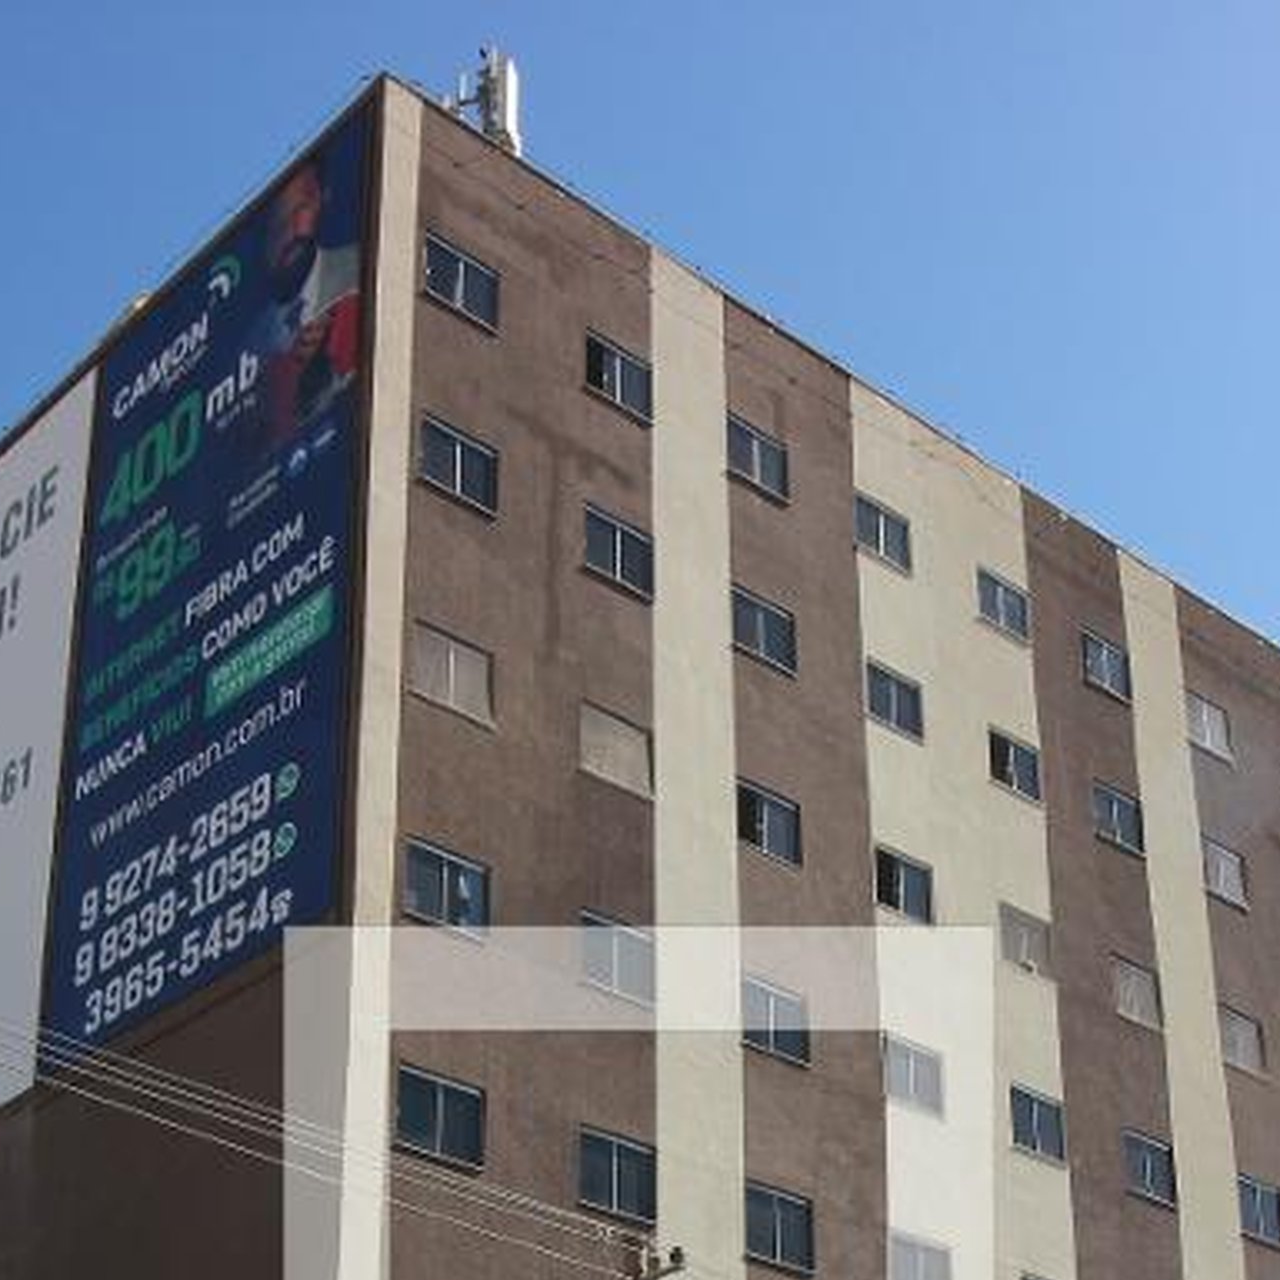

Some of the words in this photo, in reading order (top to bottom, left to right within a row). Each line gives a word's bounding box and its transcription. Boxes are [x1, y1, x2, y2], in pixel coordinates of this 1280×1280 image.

[112, 310, 209, 419] CAMON
[100, 388, 203, 527] 400
[205, 350, 259, 423] mb
[185, 558, 250, 628] FIBRA
[252, 512, 304, 575] COM
[201, 590, 268, 660] COMO
[271, 534, 336, 605] VOCÊ
[90, 678, 306, 847] www.camon.com.br
[99, 829, 270, 973] 8338-1058
[104, 772, 270, 916] 9274-2659
[84, 886, 269, 1035] 3965-5454
